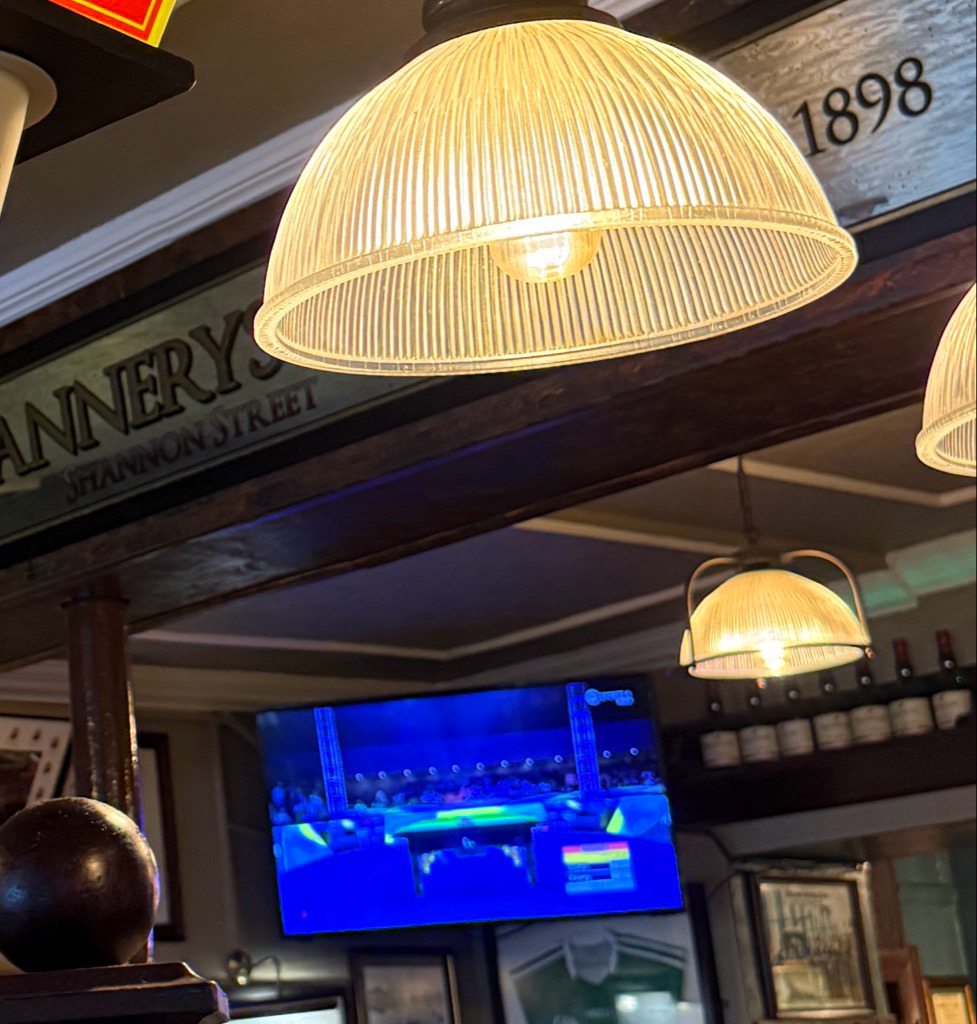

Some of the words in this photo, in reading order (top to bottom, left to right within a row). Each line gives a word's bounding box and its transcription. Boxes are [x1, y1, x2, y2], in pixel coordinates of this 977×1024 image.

[792, 57, 933, 157] 1898
[64, 419, 208, 504] SHANNON
[209, 376, 319, 448] STREET
